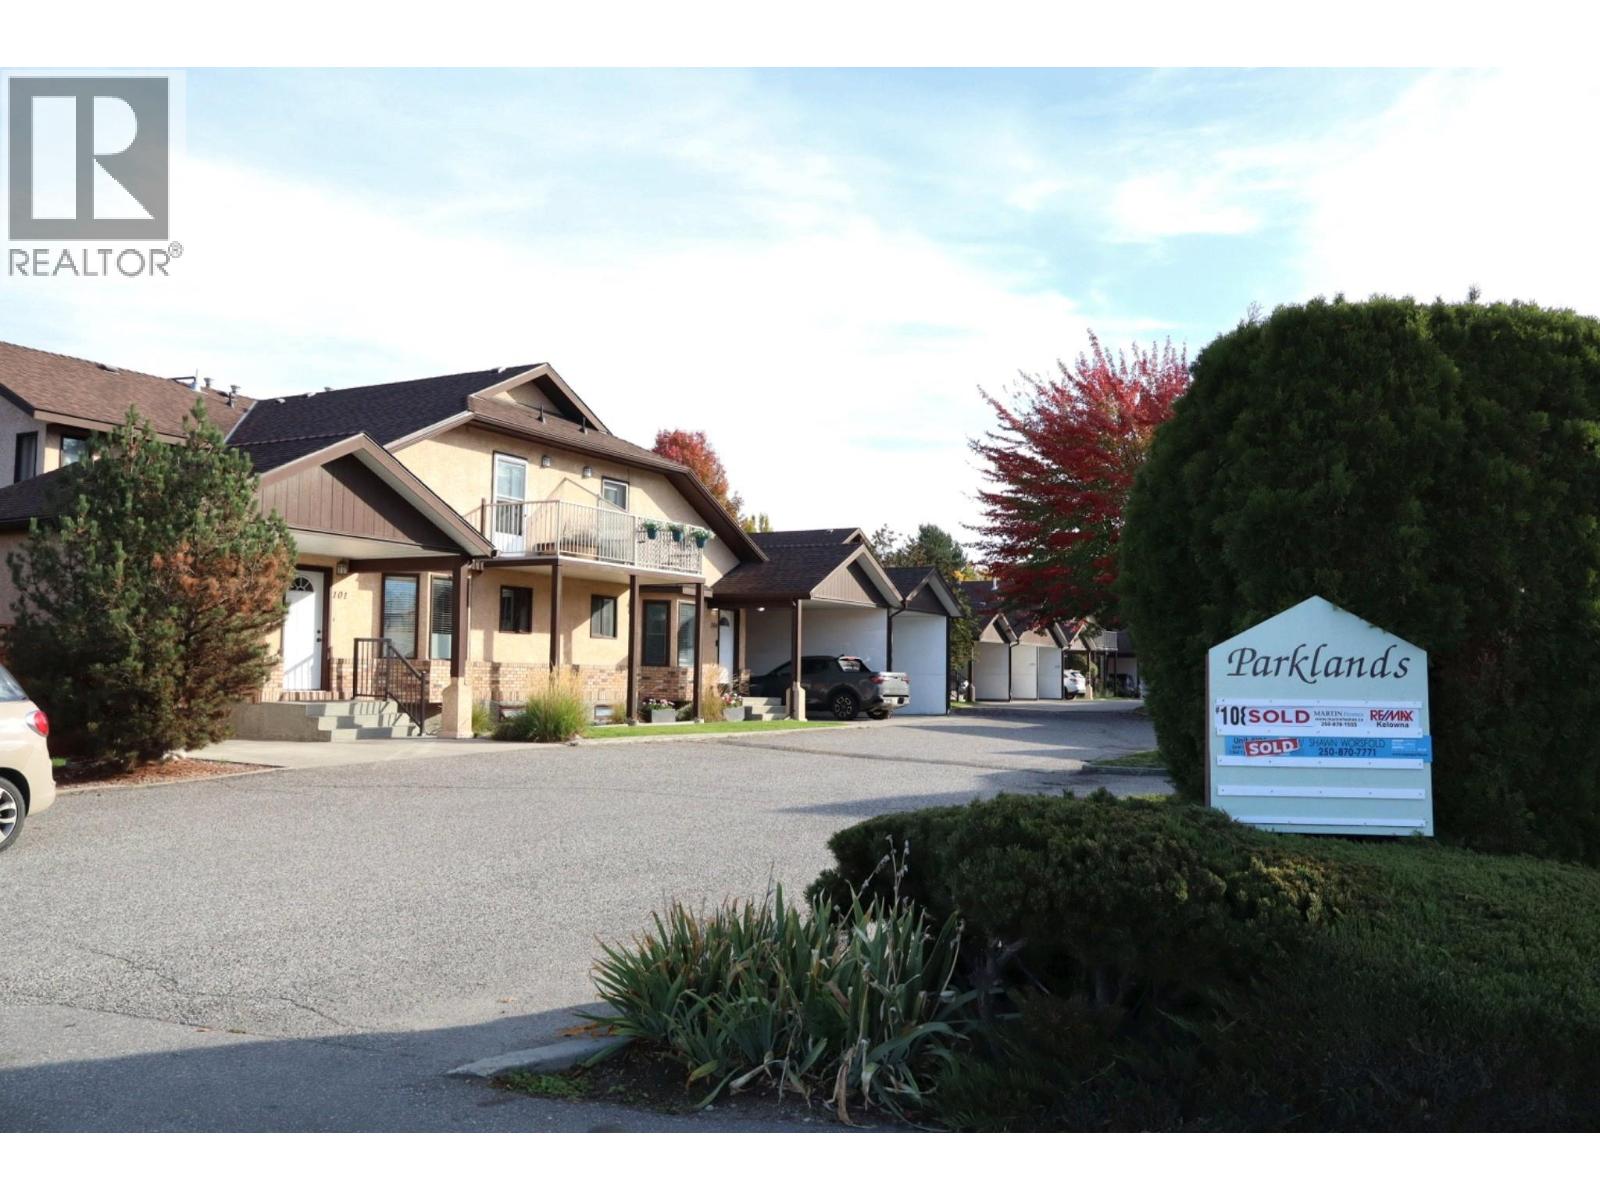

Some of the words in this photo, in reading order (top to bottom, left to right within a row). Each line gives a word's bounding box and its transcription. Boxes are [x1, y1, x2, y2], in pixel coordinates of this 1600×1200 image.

[1226, 643, 1411, 684] Parklands
[1249, 709, 1310, 724] SOLD
[1370, 709, 1414, 721] RE/MAX
[1248, 740, 1294, 756] SOLD
[1318, 747, 1377, 757] 250-870-7771
